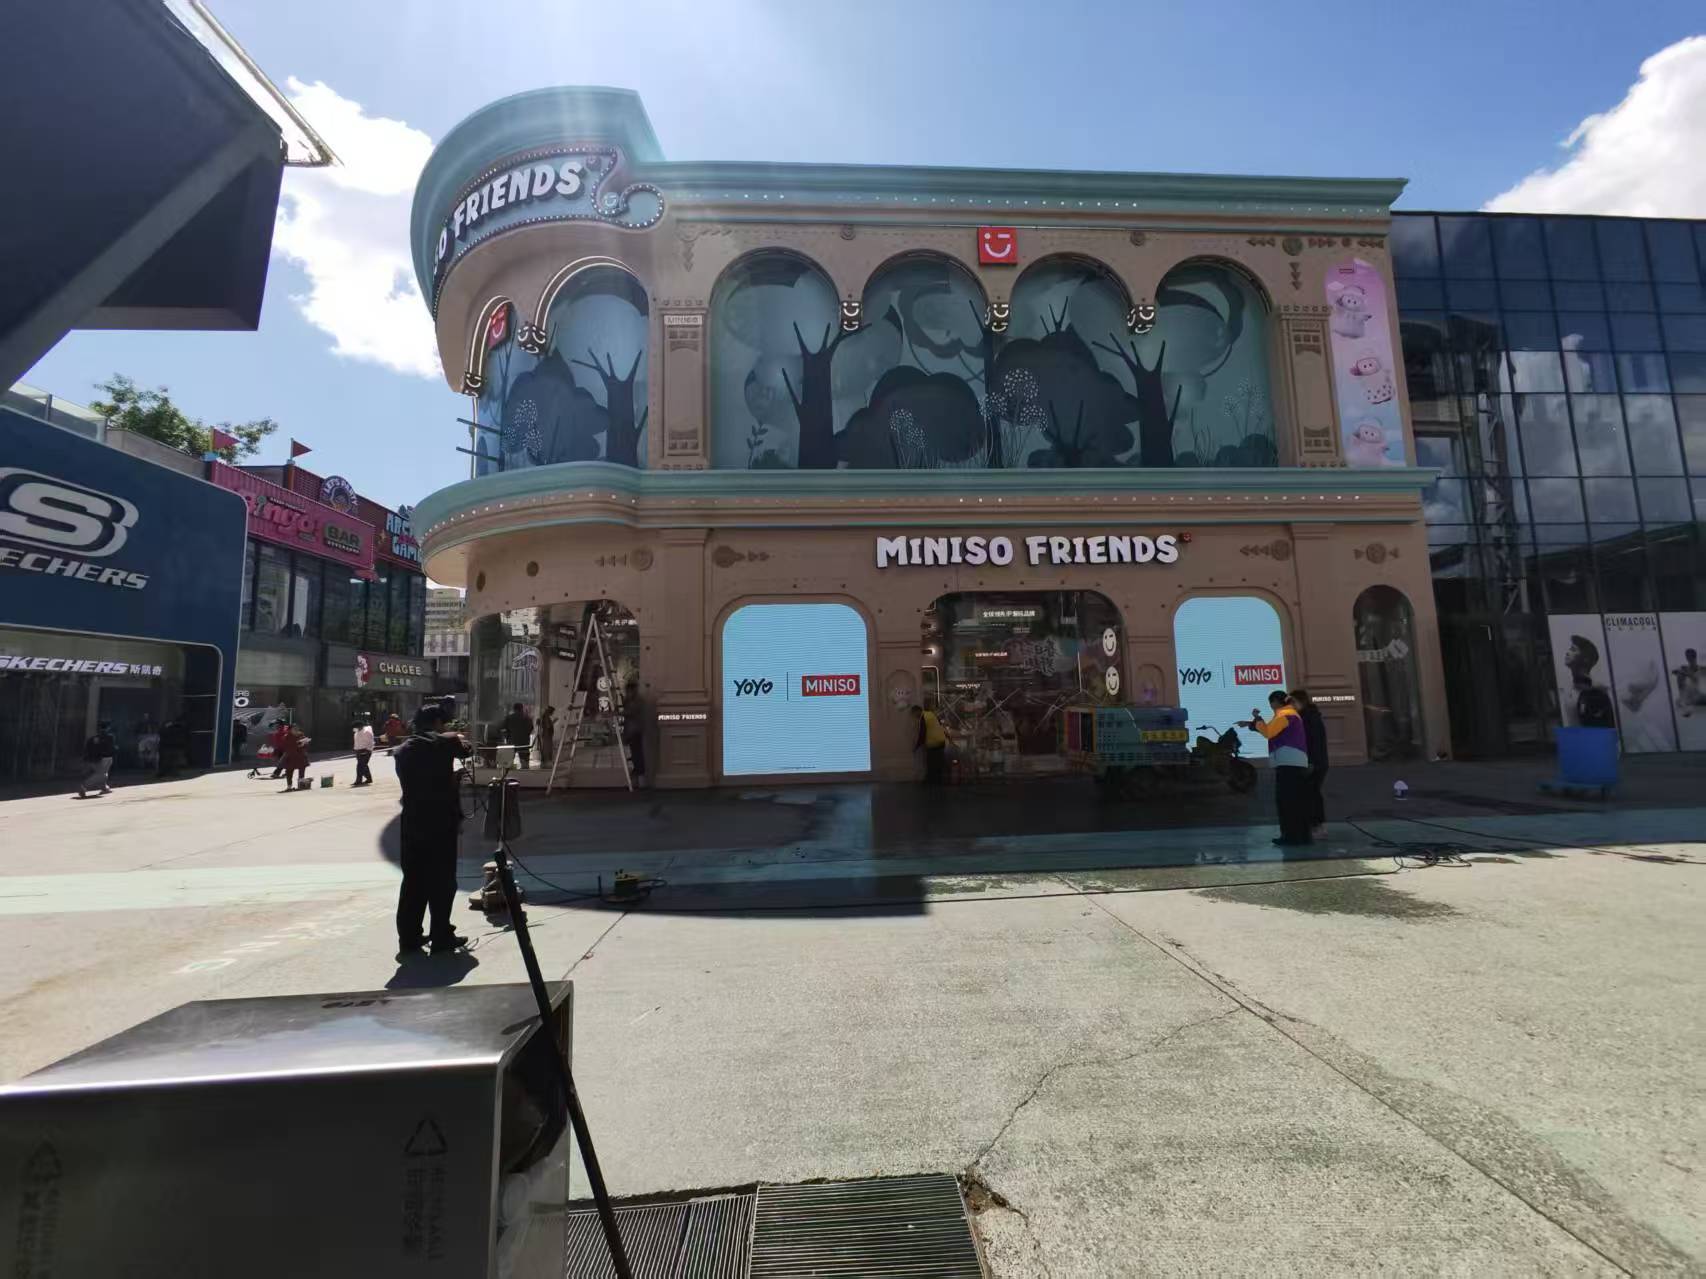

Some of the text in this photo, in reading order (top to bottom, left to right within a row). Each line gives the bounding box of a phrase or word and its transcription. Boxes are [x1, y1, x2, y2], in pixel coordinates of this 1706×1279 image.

[453, 161, 582, 239] FRIENDS
[328, 525, 360, 546] BAR
[876, 535, 1179, 568] MINISO FRIENDS
[1606, 616, 1656, 627] CLIMACOOL
[0, 655, 129, 674] SKECHERS
[379, 662, 422, 676] CHAGEE
[1237, 668, 1280, 682] MINISO
[805, 678, 855, 693] MINISO
